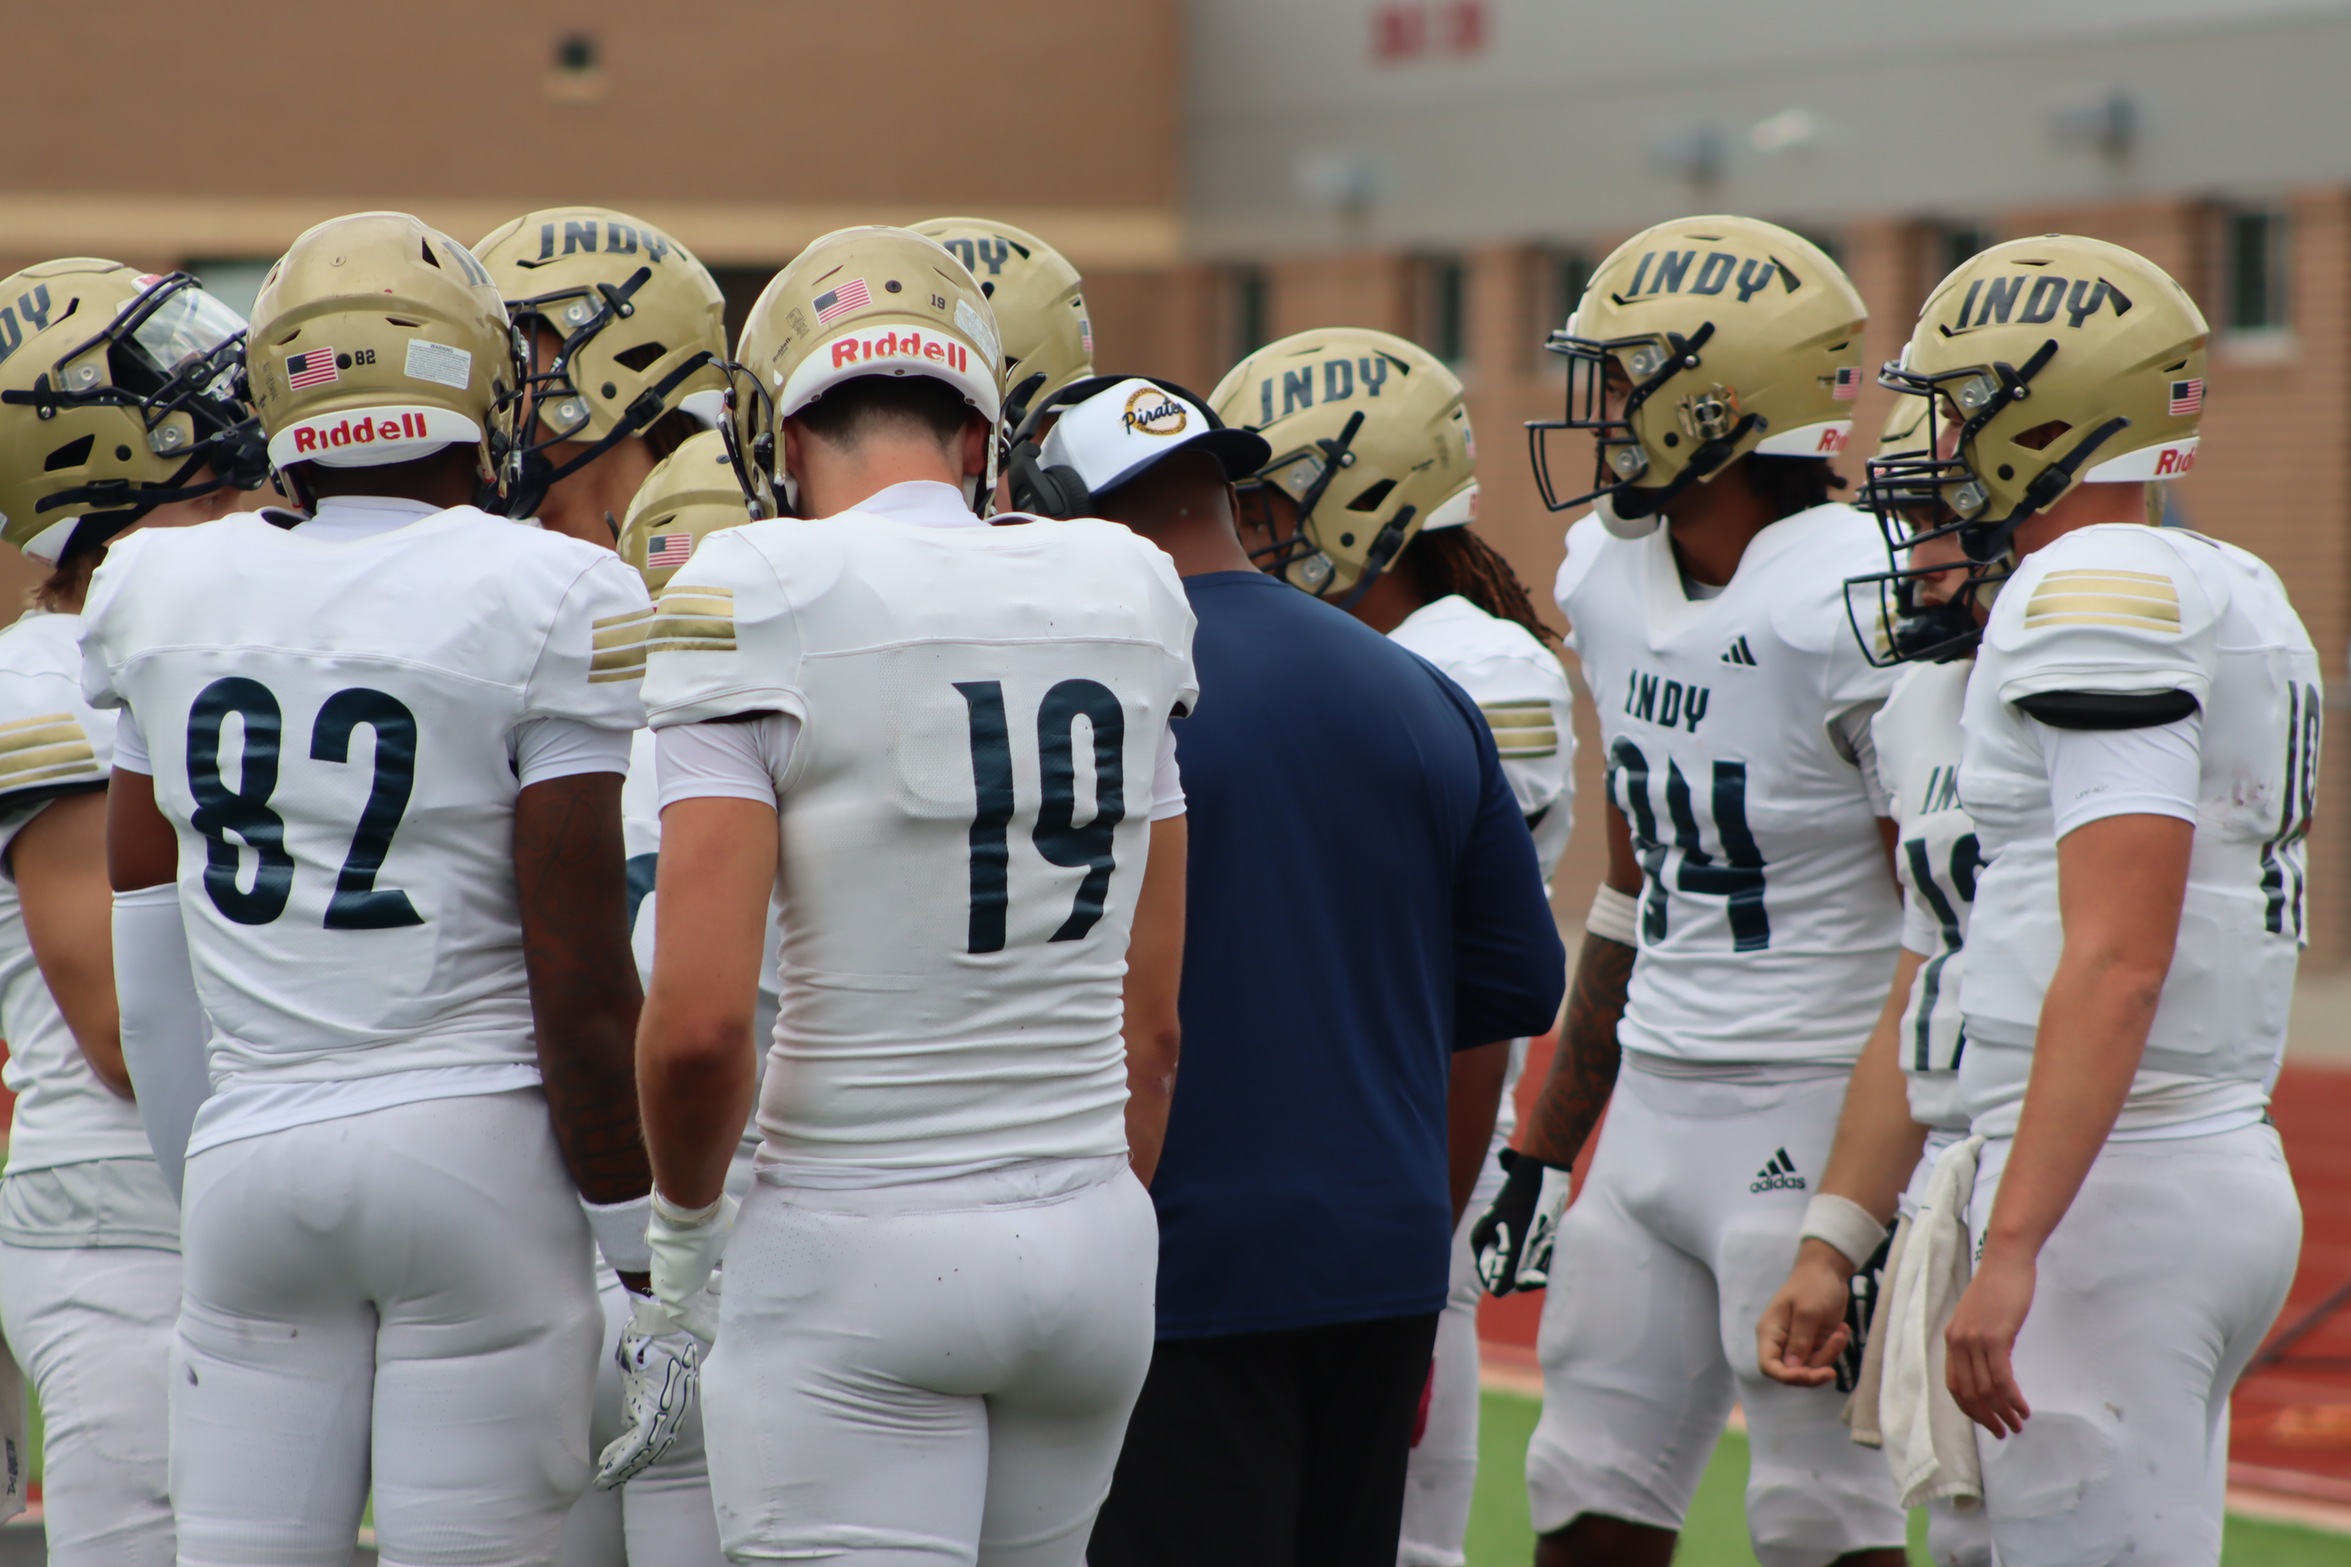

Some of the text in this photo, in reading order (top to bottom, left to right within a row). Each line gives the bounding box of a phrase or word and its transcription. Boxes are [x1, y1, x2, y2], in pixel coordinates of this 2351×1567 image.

[537, 220, 669, 263] INDY
[1625, 250, 1777, 303] INDY
[931, 293, 946, 310] 19
[1954, 275, 2111, 329] INDY
[355, 349, 376, 365] 82
[831, 332, 967, 373] Riddell
[1260, 357, 1388, 426] INDY
[293, 412, 427, 454] Riddell
[1122, 397, 1187, 435] Pirates
[1624, 669, 1710, 733] INDY
[186, 676, 425, 930] 82
[1919, 765, 1964, 816] IN
[951, 678, 1126, 954] 19
[1749, 1173, 1806, 1193] adidas
